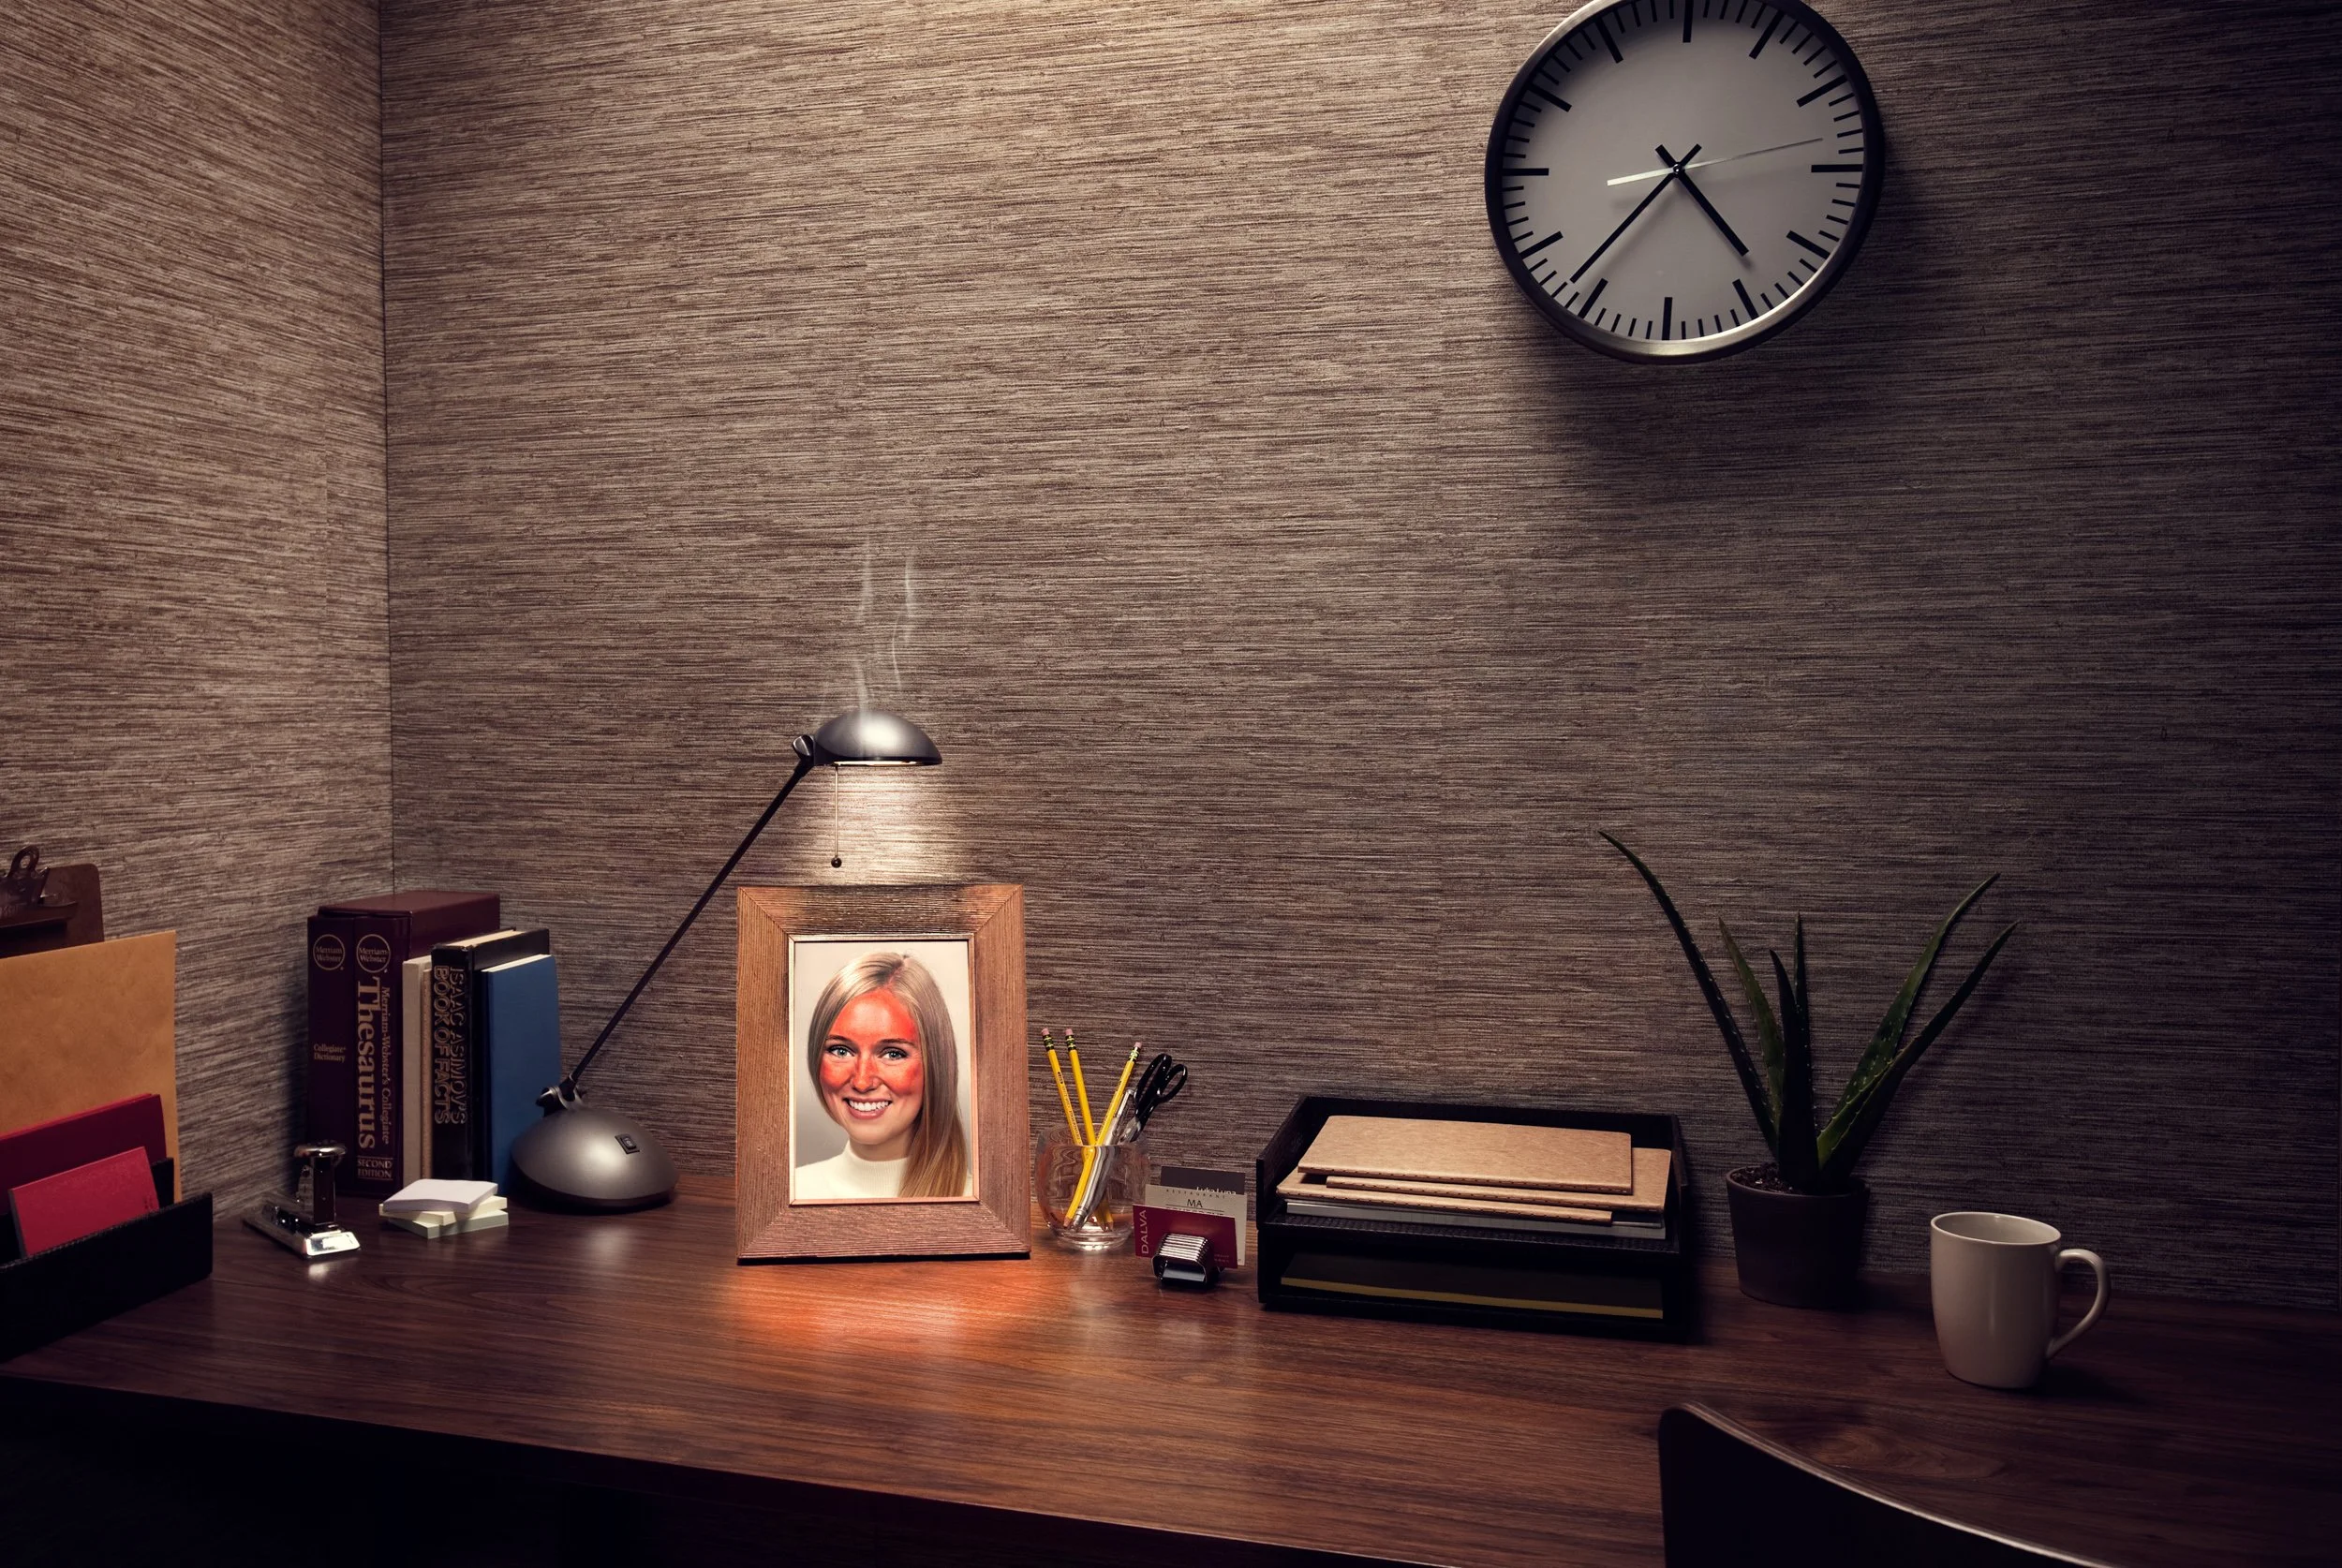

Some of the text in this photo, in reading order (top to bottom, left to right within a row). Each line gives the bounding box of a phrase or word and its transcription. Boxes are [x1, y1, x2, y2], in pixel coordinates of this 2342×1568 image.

[360, 954, 387, 963] Webster
[433, 965, 451, 1125] BOOK OF FACTS
[450, 967, 467, 1125] ISAAC ASIMOV'S
[314, 1052, 346, 1063] Dictionary
[357, 976, 381, 1149] Thesaurus
[358, 1160, 393, 1169] SECOND
[358, 1168, 393, 1177] EDITION
[1187, 1199, 1203, 1208] MA
[1139, 1209, 1149, 1255] DALVA
